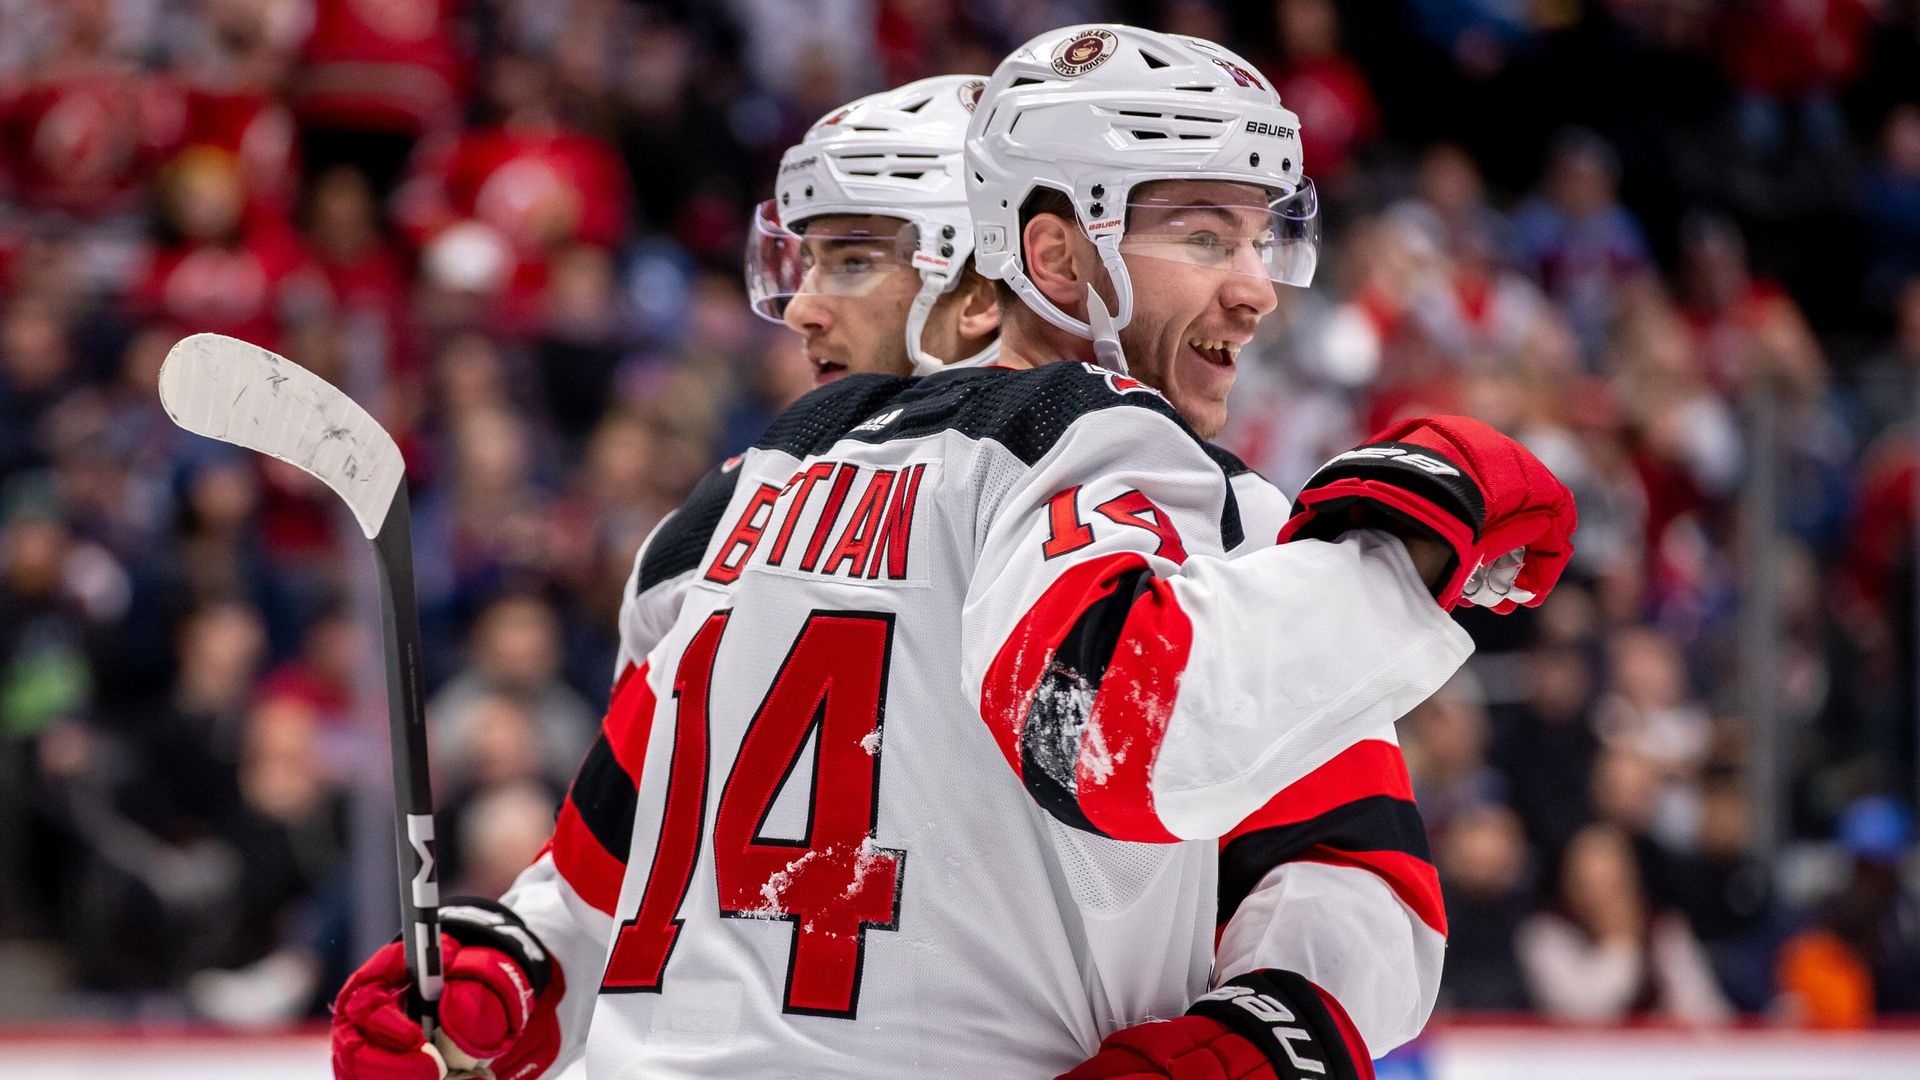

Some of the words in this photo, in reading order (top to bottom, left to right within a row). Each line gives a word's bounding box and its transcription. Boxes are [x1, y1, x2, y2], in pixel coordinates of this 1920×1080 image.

[1054, 57, 1078, 74] COFFEE
[1080, 53, 1109, 72] HOUSE
[703, 462, 927, 585] BTIAN
[599, 606, 907, 1020] 14
